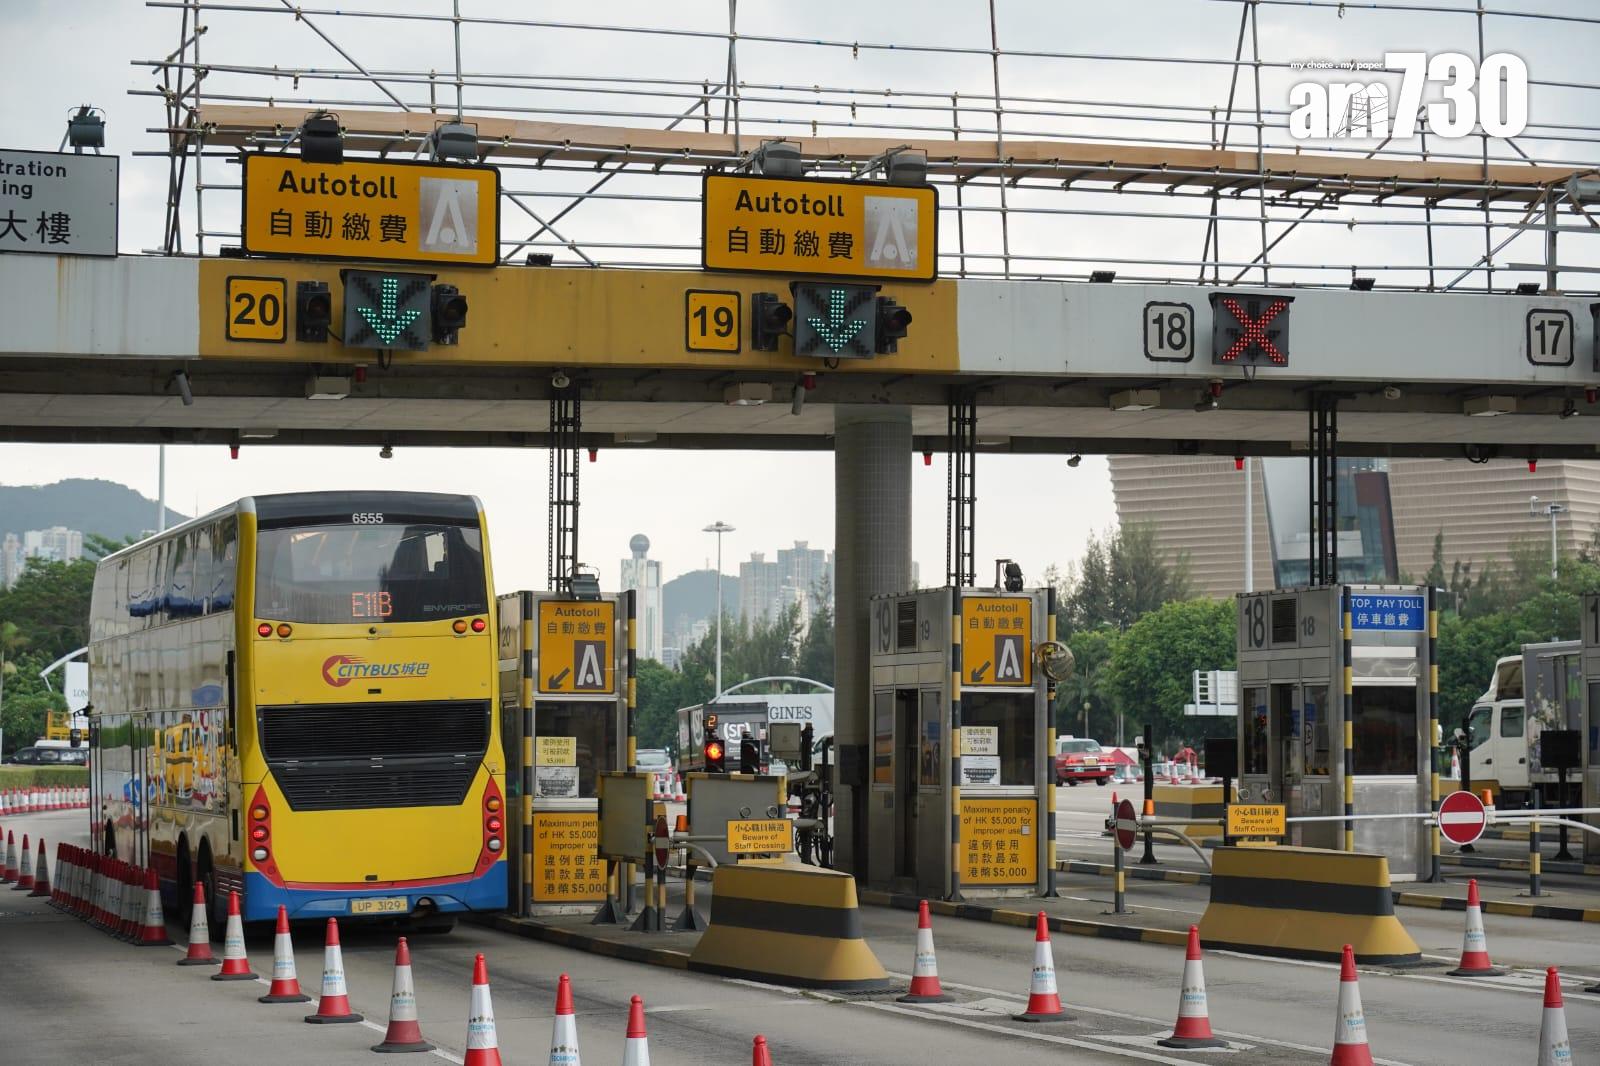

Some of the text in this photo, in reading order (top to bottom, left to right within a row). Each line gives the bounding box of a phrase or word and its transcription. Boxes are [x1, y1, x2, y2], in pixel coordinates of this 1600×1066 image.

[2, 180, 33, 199] ing
[278, 169, 398, 200] Autotoll
[735, 189, 845, 217] Autotoll
[0, 209, 71, 244] 大樓
[270, 208, 408, 244] 自動繳費
[728, 226, 854, 260] 自動繳費
[233, 292, 281, 327] 20
[693, 305, 734, 338] 19
[1152, 312, 1187, 351] 18
[1534, 319, 1565, 356] 17
[351, 512, 384, 525] 6555
[351, 591, 393, 617] E11B
[976, 603, 1019, 613] Autotoll
[1376, 599, 1396, 609] PAY
[1398, 599, 1423, 609] TOLL
[554, 607, 600, 617] Autotoll
[1356, 613, 1410, 626] 停車繳費
[547, 621, 607, 635] 自動繳費
[875, 601, 892, 653] 19
[919, 619, 931, 641] 19
[968, 617, 1025, 631] 自動繳費
[1244, 598, 1265, 649] 18
[1300, 615, 1316, 637] 18
[338, 662, 430, 678] CITYBUS 城巴
[768, 706, 813, 720] GINES
[707, 715, 717, 728] 2
[963, 805, 1032, 815] Maximum penalty
[963, 816, 972, 825] of
[975, 816, 988, 825] HK
[991, 816, 1017, 826] $5,000
[539, 830, 548, 840] of
[552, 830, 566, 839] HK
[973, 827, 1006, 836] improper
[550, 842, 585, 851] improper
[734, 842, 786, 850] Staff Crossing
[357, 900, 401, 912] UP 3129
